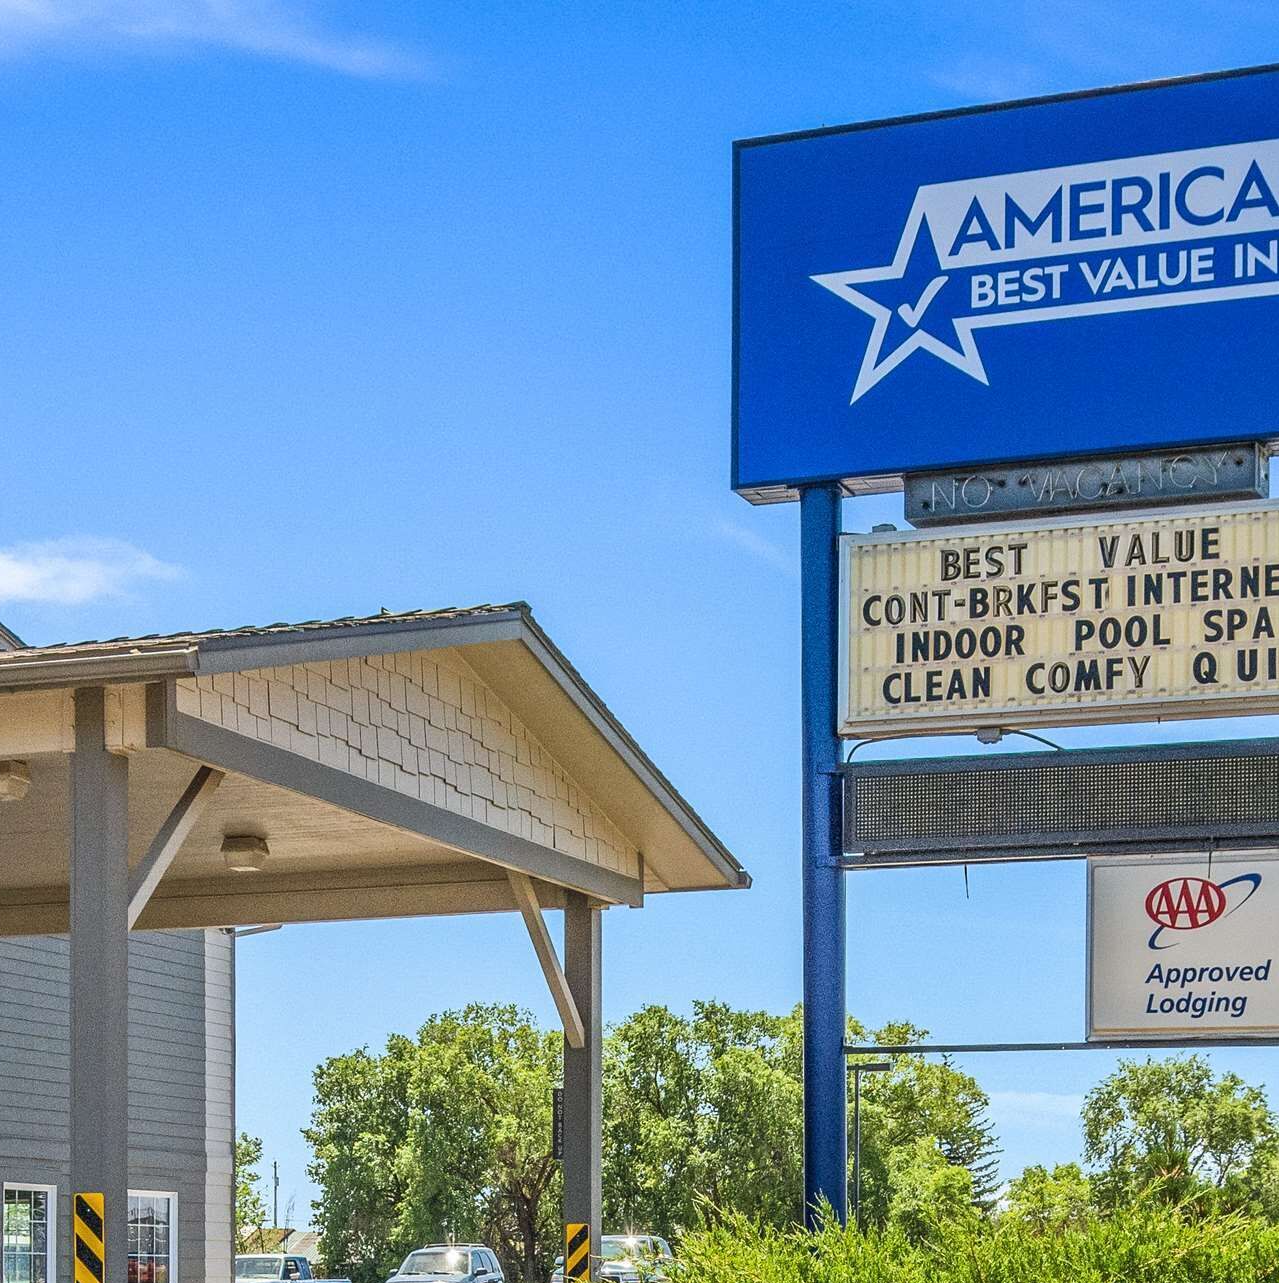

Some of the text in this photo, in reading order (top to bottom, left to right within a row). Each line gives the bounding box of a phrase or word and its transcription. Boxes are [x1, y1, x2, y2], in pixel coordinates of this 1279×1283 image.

[970, 262, 1069, 309] BEST
[1079, 247, 1215, 296] VALUE
[930, 451, 1232, 513] NO VACANCY
[940, 527, 1220, 581] BEST VALUE
[895, 606, 1276, 665] INDOOR POOL SPA
[882, 666, 992, 704] CLEAN
[1025, 655, 1151, 695] COMFY
[1151, 879, 1219, 929] AAA
[1145, 959, 1271, 988] Approved
[1146, 991, 1248, 1018] Lodging
